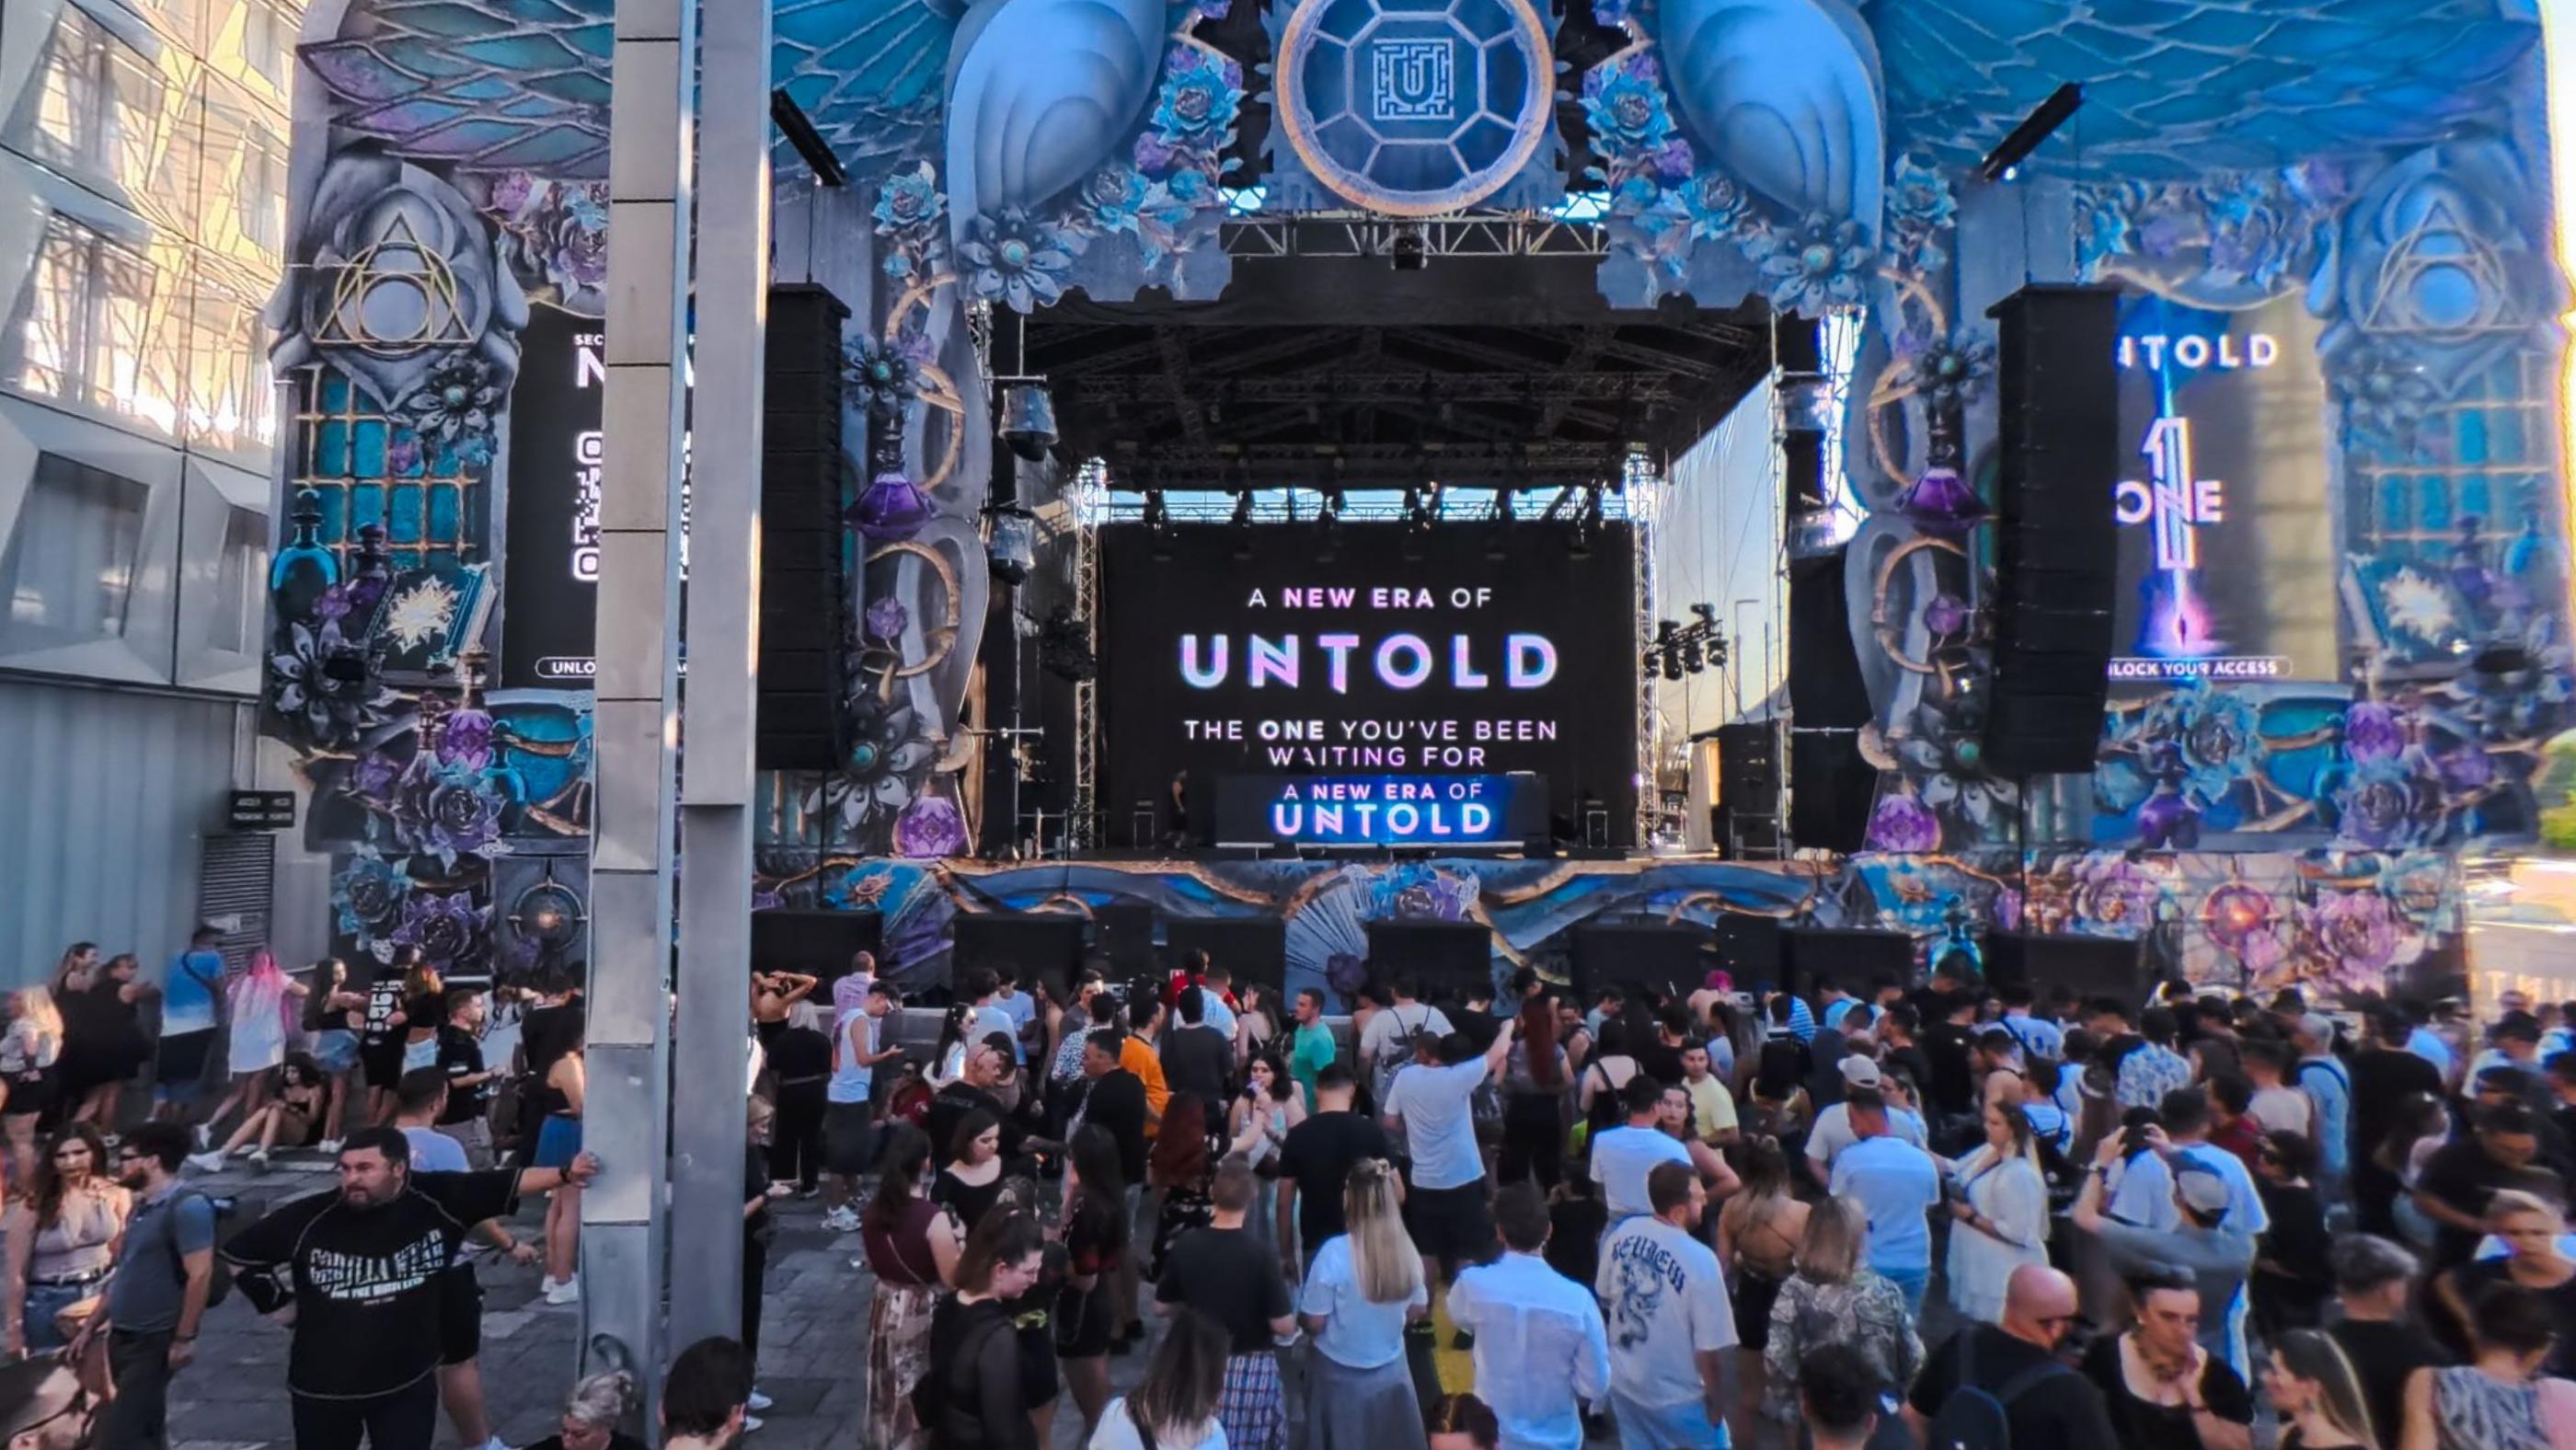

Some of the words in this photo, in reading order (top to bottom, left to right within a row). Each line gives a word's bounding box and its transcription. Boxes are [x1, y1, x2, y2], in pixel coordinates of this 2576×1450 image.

[1248, 588, 1267, 607] A
[1282, 587, 1356, 608] NEW
[1371, 587, 1435, 608] ERA
[1451, 587, 1491, 608] OF
[1179, 633, 1558, 694] UNTOLD
[2213, 661, 2278, 675] ACCESS
[1184, 719, 1243, 741] THE
[1258, 719, 1325, 741] ONE
[1340, 719, 1458, 741] YOU'VE
[1474, 719, 1557, 741] BEEN
[1422, 746, 1485, 766] FOR
[1283, 784, 1298, 800] A
[1313, 784, 1371, 800] NEW
[1385, 783, 1435, 800] ERA
[1449, 783, 1482, 800] OF
[1274, 803, 1491, 837] UNTOLD
